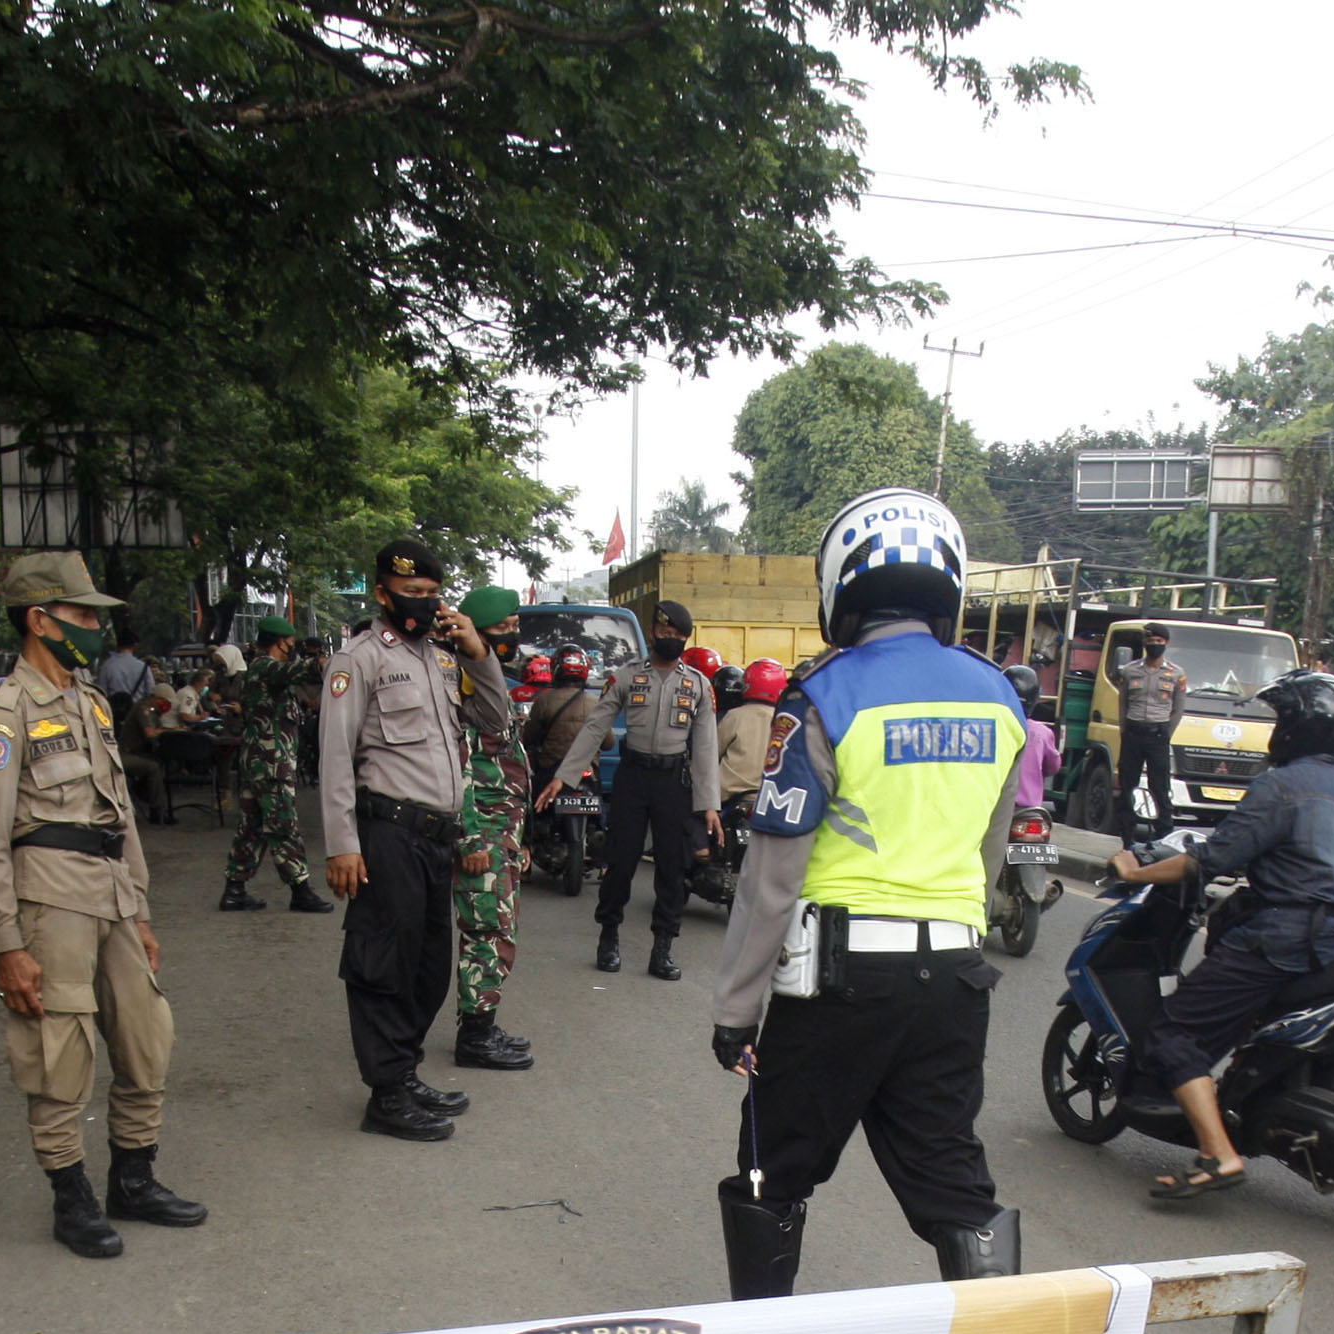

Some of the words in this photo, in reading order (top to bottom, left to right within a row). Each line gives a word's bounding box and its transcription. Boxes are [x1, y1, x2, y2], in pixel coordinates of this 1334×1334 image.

[863, 506, 948, 532] POLISI
[889, 722, 993, 760] POLISI
[755, 779, 808, 824] M
